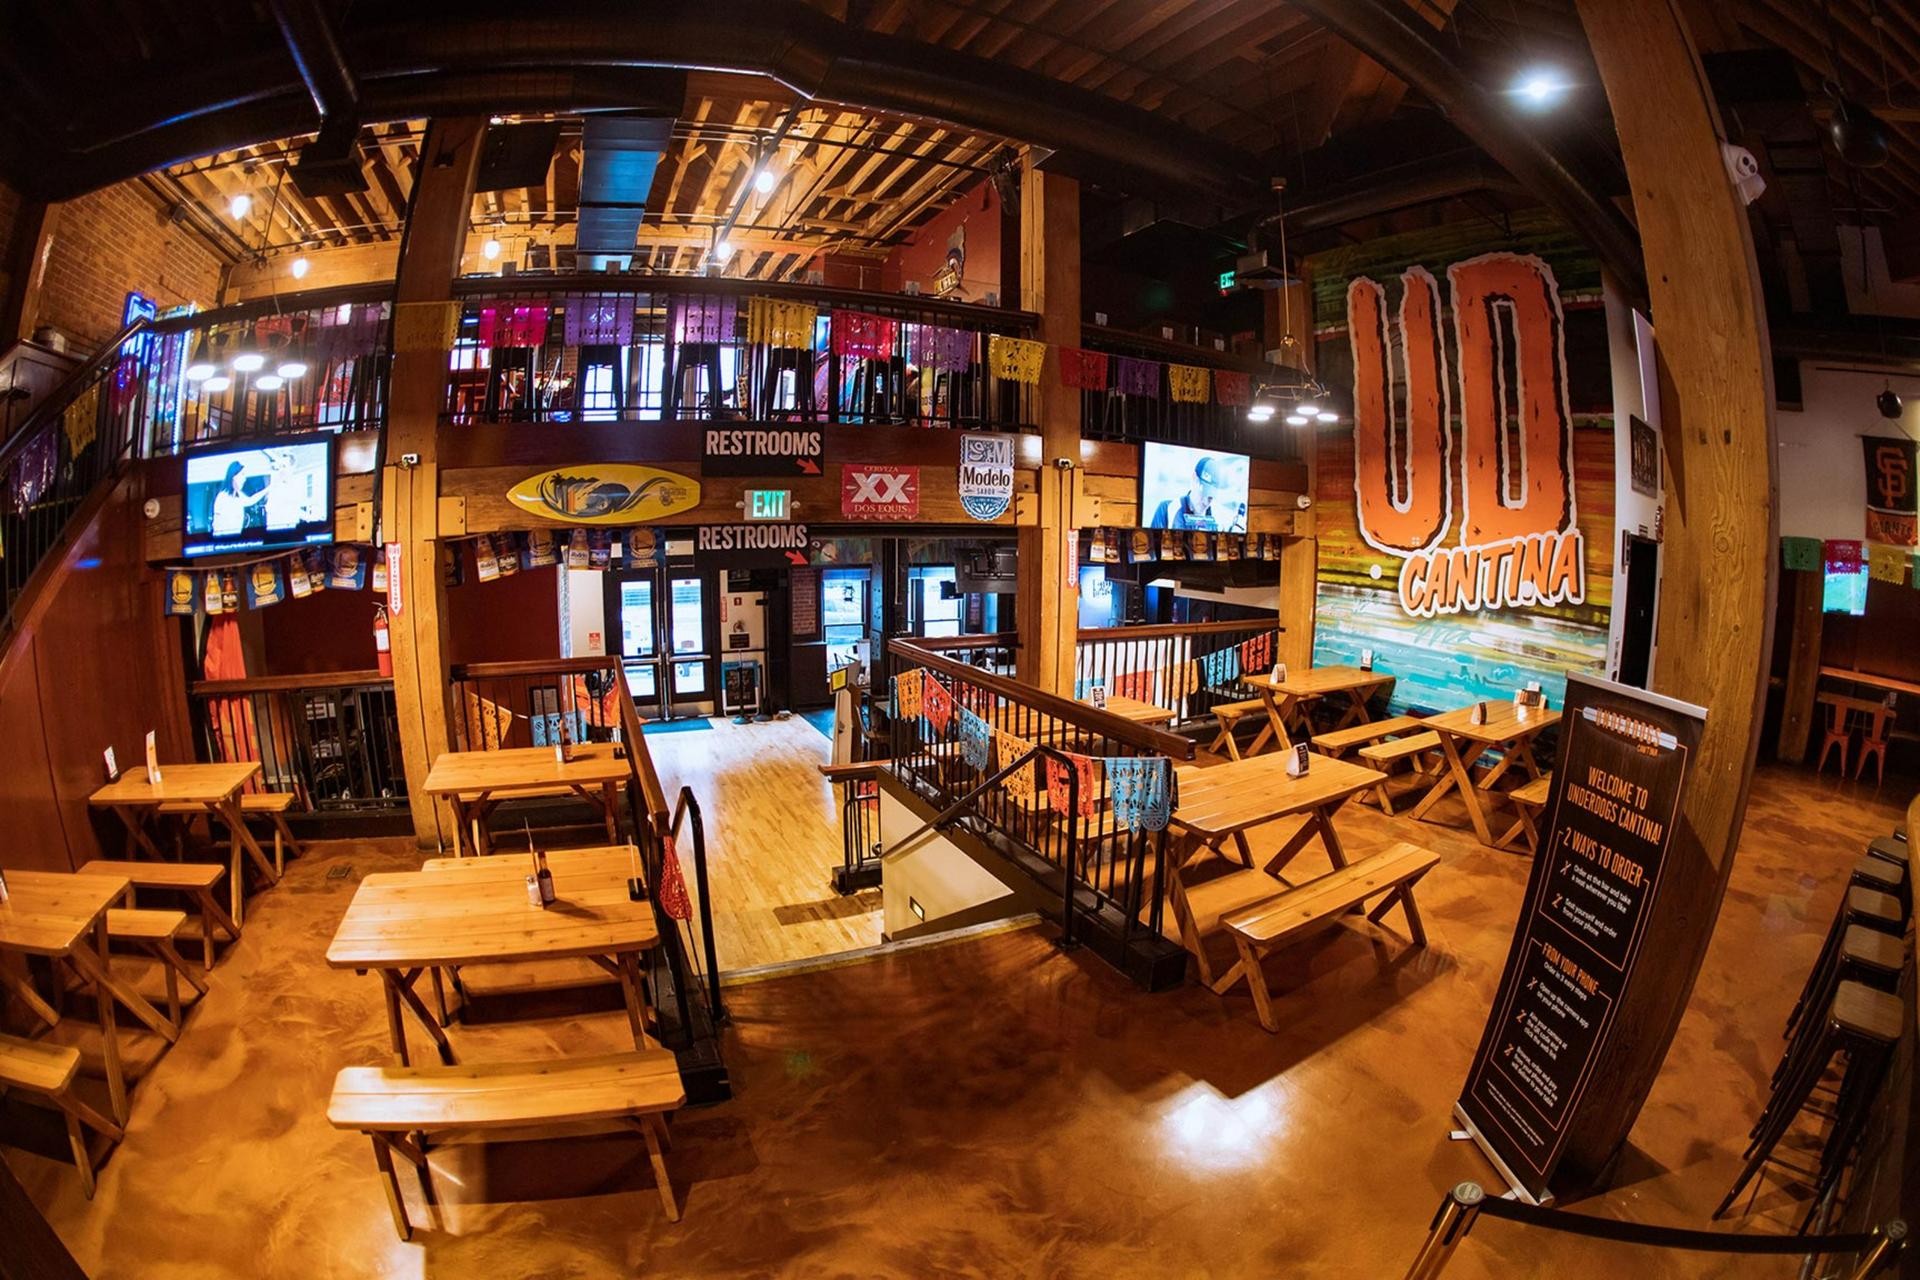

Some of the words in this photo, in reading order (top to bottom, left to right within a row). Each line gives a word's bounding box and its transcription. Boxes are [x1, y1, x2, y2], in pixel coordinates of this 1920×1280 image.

[1347, 252, 1576, 555] UD
[705, 430, 821, 456] RESTROOMS
[864, 465, 898, 473] CERVEZA
[963, 466, 1010, 487] Modelo
[852, 472, 910, 503] XX
[752, 490, 786, 518] EXIT
[854, 504, 877, 512] DOS
[878, 504, 906, 513] EQUIS
[698, 525, 808, 551] RESTROOMS
[1872, 519, 1913, 536] GIANTS
[1399, 529, 1584, 617] CANTINA
[1596, 706, 1661, 747] UNDERDOGS
[1588, 766, 1634, 803] WELCOME
[1636, 786, 1648, 810] TO
[1567, 782, 1619, 823] UNDERDOGS
[1618, 806, 1664, 845] CANTINA!
[1563, 827, 1572, 846] 2
[1572, 831, 1597, 860] WAYS
[1598, 845, 1611, 869] TO
[1611, 853, 1643, 888] ORDER
[1574, 865, 1586, 877] Order
[1592, 877, 1601, 886] the
[1601, 881, 1609, 891] bar
[1609, 888, 1619, 898] and
[1620, 893, 1631, 905] take
[1576, 877, 1586, 887] seat
[1586, 884, 1607, 900] wherever
[1607, 898, 1616, 907] you
[1617, 902, 1626, 913] like
[1563, 906, 1573, 919] from
[1572, 914, 1584, 926] your
[1584, 923, 1599, 936] phone
[1565, 898, 1575, 910] Seat
[1574, 906, 1595, 922] yourself
[1594, 919, 1604, 929] and
[1603, 926, 1617, 938] order
[1542, 942, 1561, 965] FROM
[1560, 956, 1577, 978] YOUR
[1577, 968, 1599, 995] PHONE
[1544, 961, 1556, 975] Order
[1564, 979, 1575, 991] easy
[1574, 987, 1587, 1001] steps
[1540, 982, 1550, 995] Open
[1564, 1004, 1580, 1020] camera
[1579, 1018, 1589, 1028] app
[1542, 996, 1552, 1006] your
[1551, 1004, 1566, 1018] phone
[1537, 1020, 1547, 1030] your
[1546, 1028, 1562, 1045] camera
[1540, 1032, 1550, 1043] code
[1550, 1042, 1559, 1051] and
[1522, 1064, 1532, 1074] your
[1531, 1072, 1544, 1087] phone
[1543, 1085, 1552, 1095] and
[1531, 1062, 1542, 1074] order
[1542, 1072, 1550, 1082] and
[1534, 1086, 1544, 1096] your
